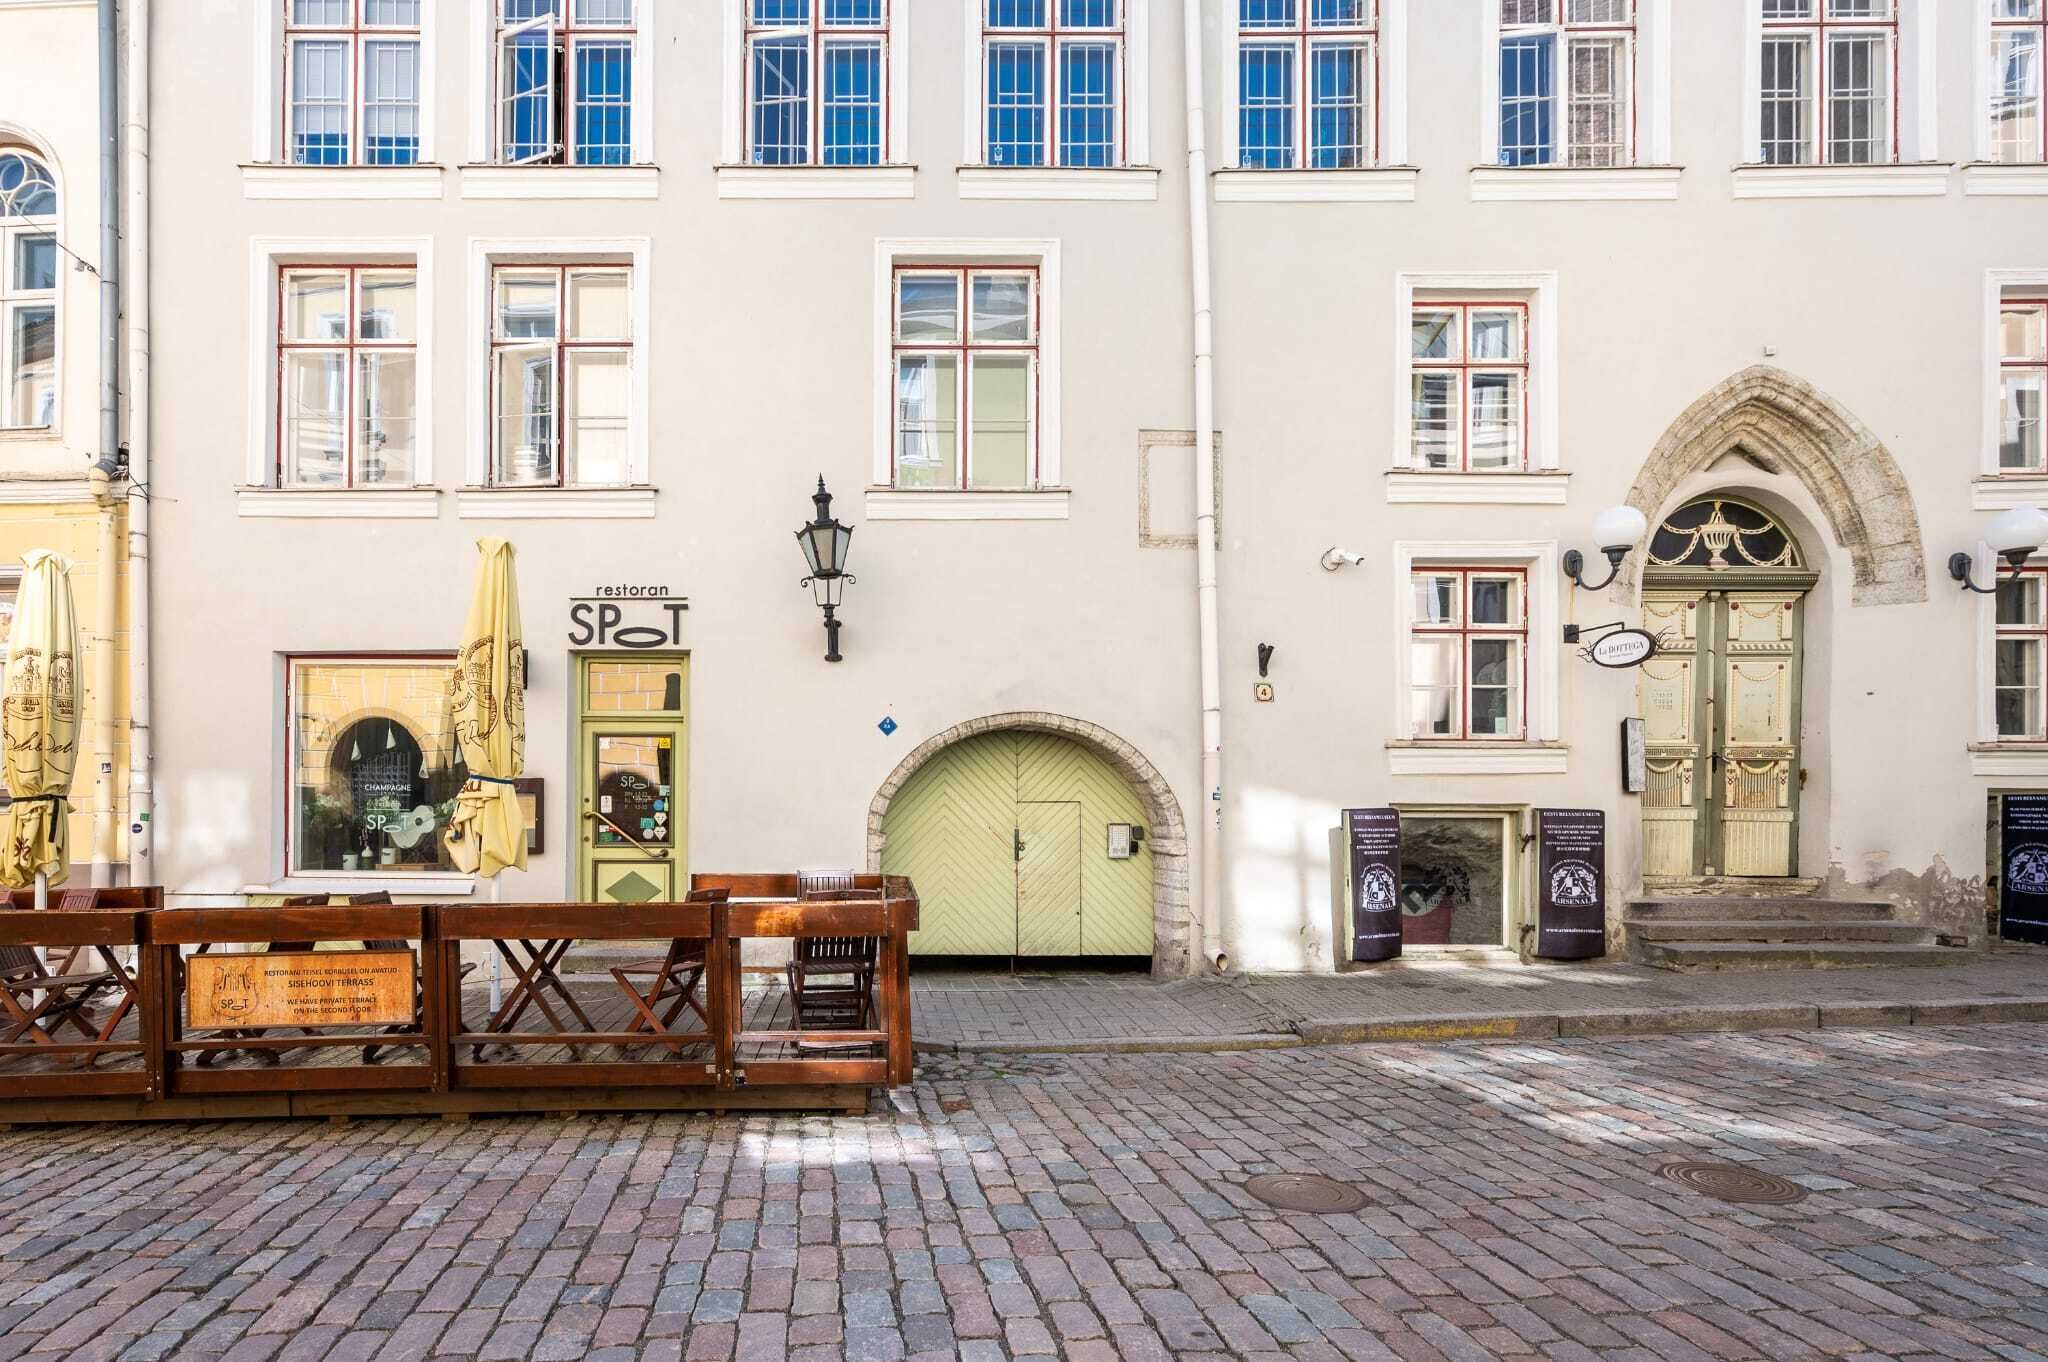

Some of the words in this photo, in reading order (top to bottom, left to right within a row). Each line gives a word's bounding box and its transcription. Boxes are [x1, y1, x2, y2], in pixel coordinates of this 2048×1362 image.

[596, 583, 668, 597] restoran
[568, 603, 689, 648] SPOT
[1609, 641, 1644, 653] BOTTEGA
[364, 783, 412, 792] CHAMPAGNE
[367, 814, 409, 832] SPOT
[1367, 902, 1393, 910] ARSENAL
[1557, 897, 1590, 905] ARSENAL
[324, 968, 358, 976] KORRUSEL
[371, 967, 398, 975] AVATUD
[288, 979, 334, 988] SISEHOOVI
[336, 978, 374, 987] TERRASS
[220, 998, 249, 1010] SPOT
[287, 998, 299, 1006] WE
[319, 997, 347, 1005] PRIVATE
[349, 996, 377, 1004] TERRACE
[320, 1006, 348, 1014] SECOND
